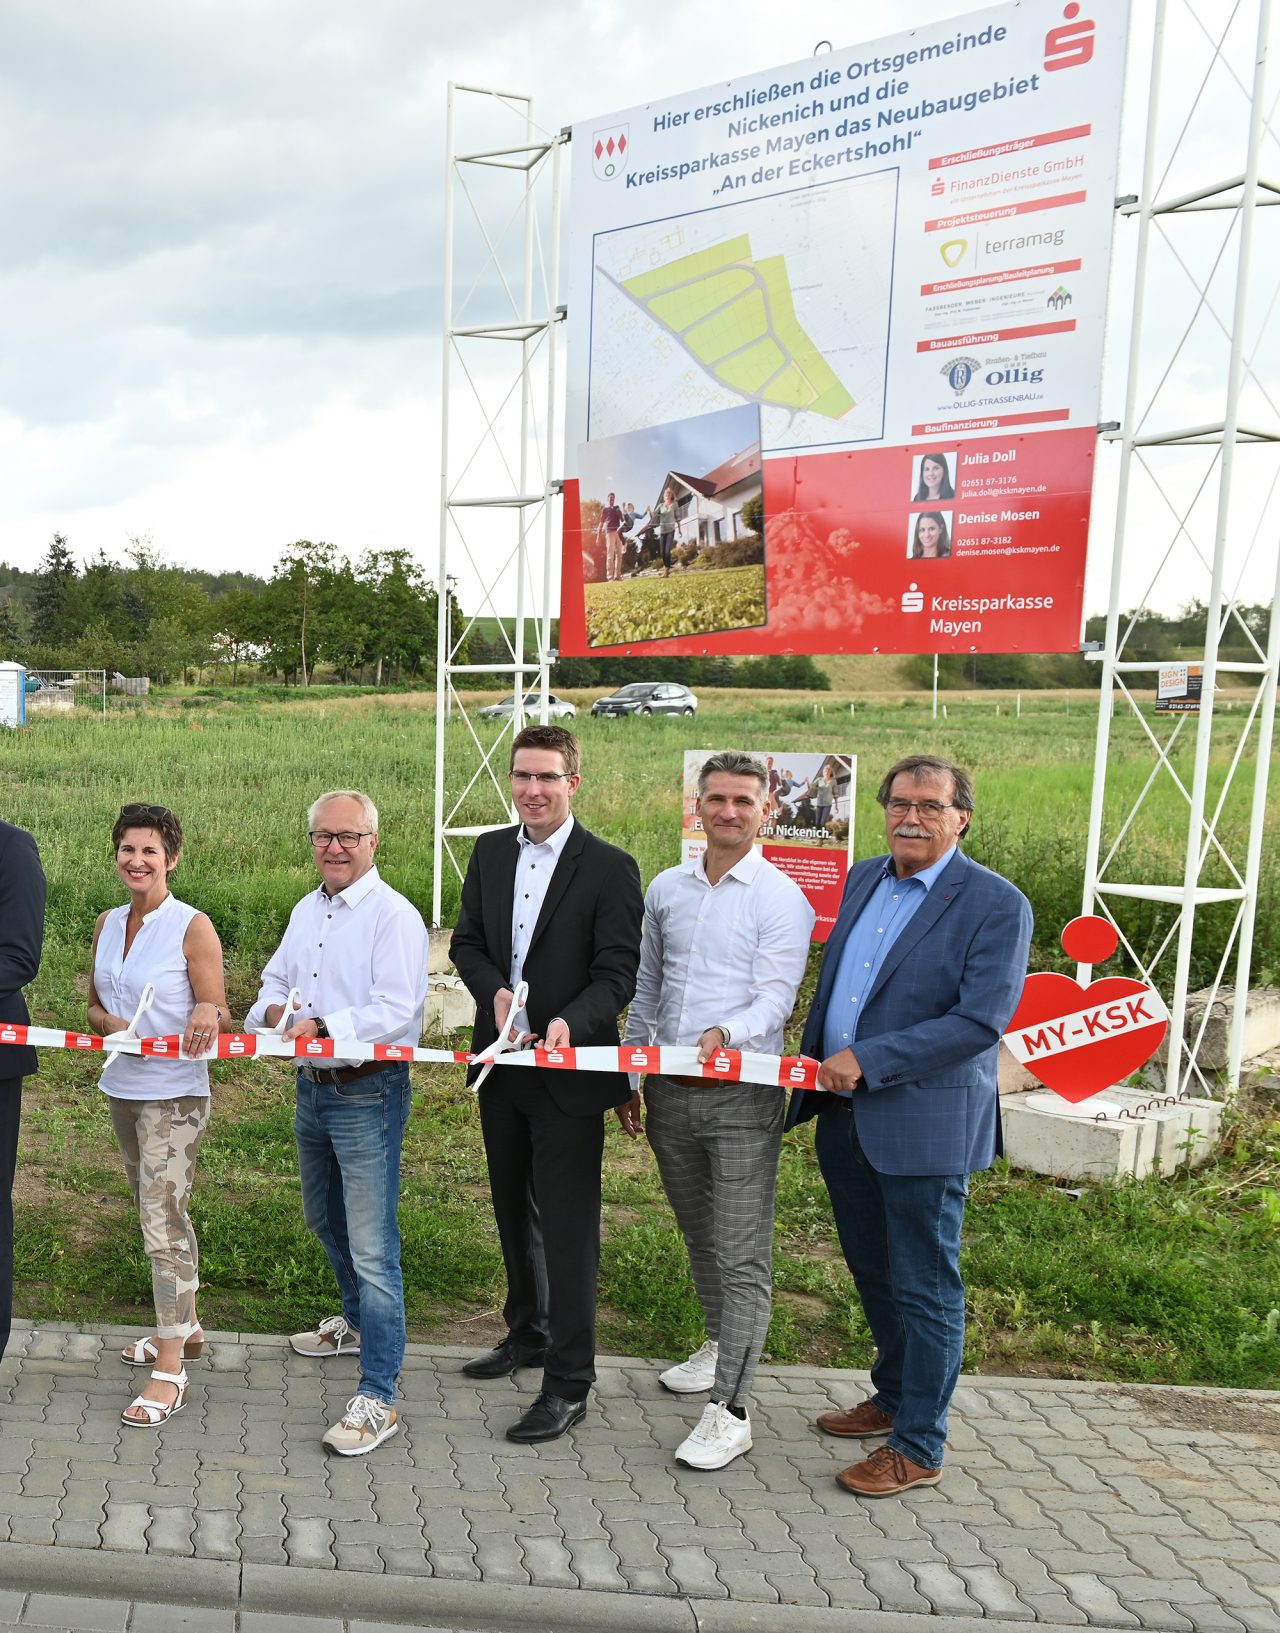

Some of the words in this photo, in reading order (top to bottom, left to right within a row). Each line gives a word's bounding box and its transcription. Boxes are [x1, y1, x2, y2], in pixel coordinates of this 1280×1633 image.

[653, 111, 691, 132] Hier
[694, 80, 805, 121] erschließen
[810, 69, 841, 89] die
[846, 25, 1007, 80] Ortsgemeinde
[728, 100, 824, 138] Nickenich
[830, 87, 870, 112] und
[876, 78, 909, 101] die
[626, 146, 760, 189] Kreissparkasse
[766, 128, 830, 156] Mayen
[835, 117, 871, 138] das
[877, 73, 1040, 129] Neubaugebiet
[941, 138, 1035, 166] Erschließungsträger
[751, 165, 784, 185] der
[950, 165, 1040, 193] FinanzDienste
[1043, 154, 1085, 174] GmbH
[937, 206, 1017, 228] Projektsteuerung
[985, 229, 1065, 254] terramag
[930, 332, 999, 350] Bauausführung
[985, 367, 1045, 387] Ollig
[925, 419, 999, 433] Baufinanzierung
[961, 452, 990, 466] Julia
[992, 449, 1016, 464] Doll
[961, 478, 984, 488] 02651
[986, 476, 1017, 486] 87-3176
[961, 484, 1047, 499] julia.doll@kskmayen.de
[958, 512, 998, 524] Denise
[1001, 509, 1040, 522] Mosen
[956, 544, 1060, 557] denise.mosen@kskmayen.de
[957, 538, 979, 546] 02651
[981, 536, 1012, 545] 87-3182
[931, 593, 1054, 614] Kreissparkasse
[929, 618, 982, 637] Mayen
[776, 825, 832, 839] Nickenich.
[1022, 997, 1154, 1056] MY-KSK
